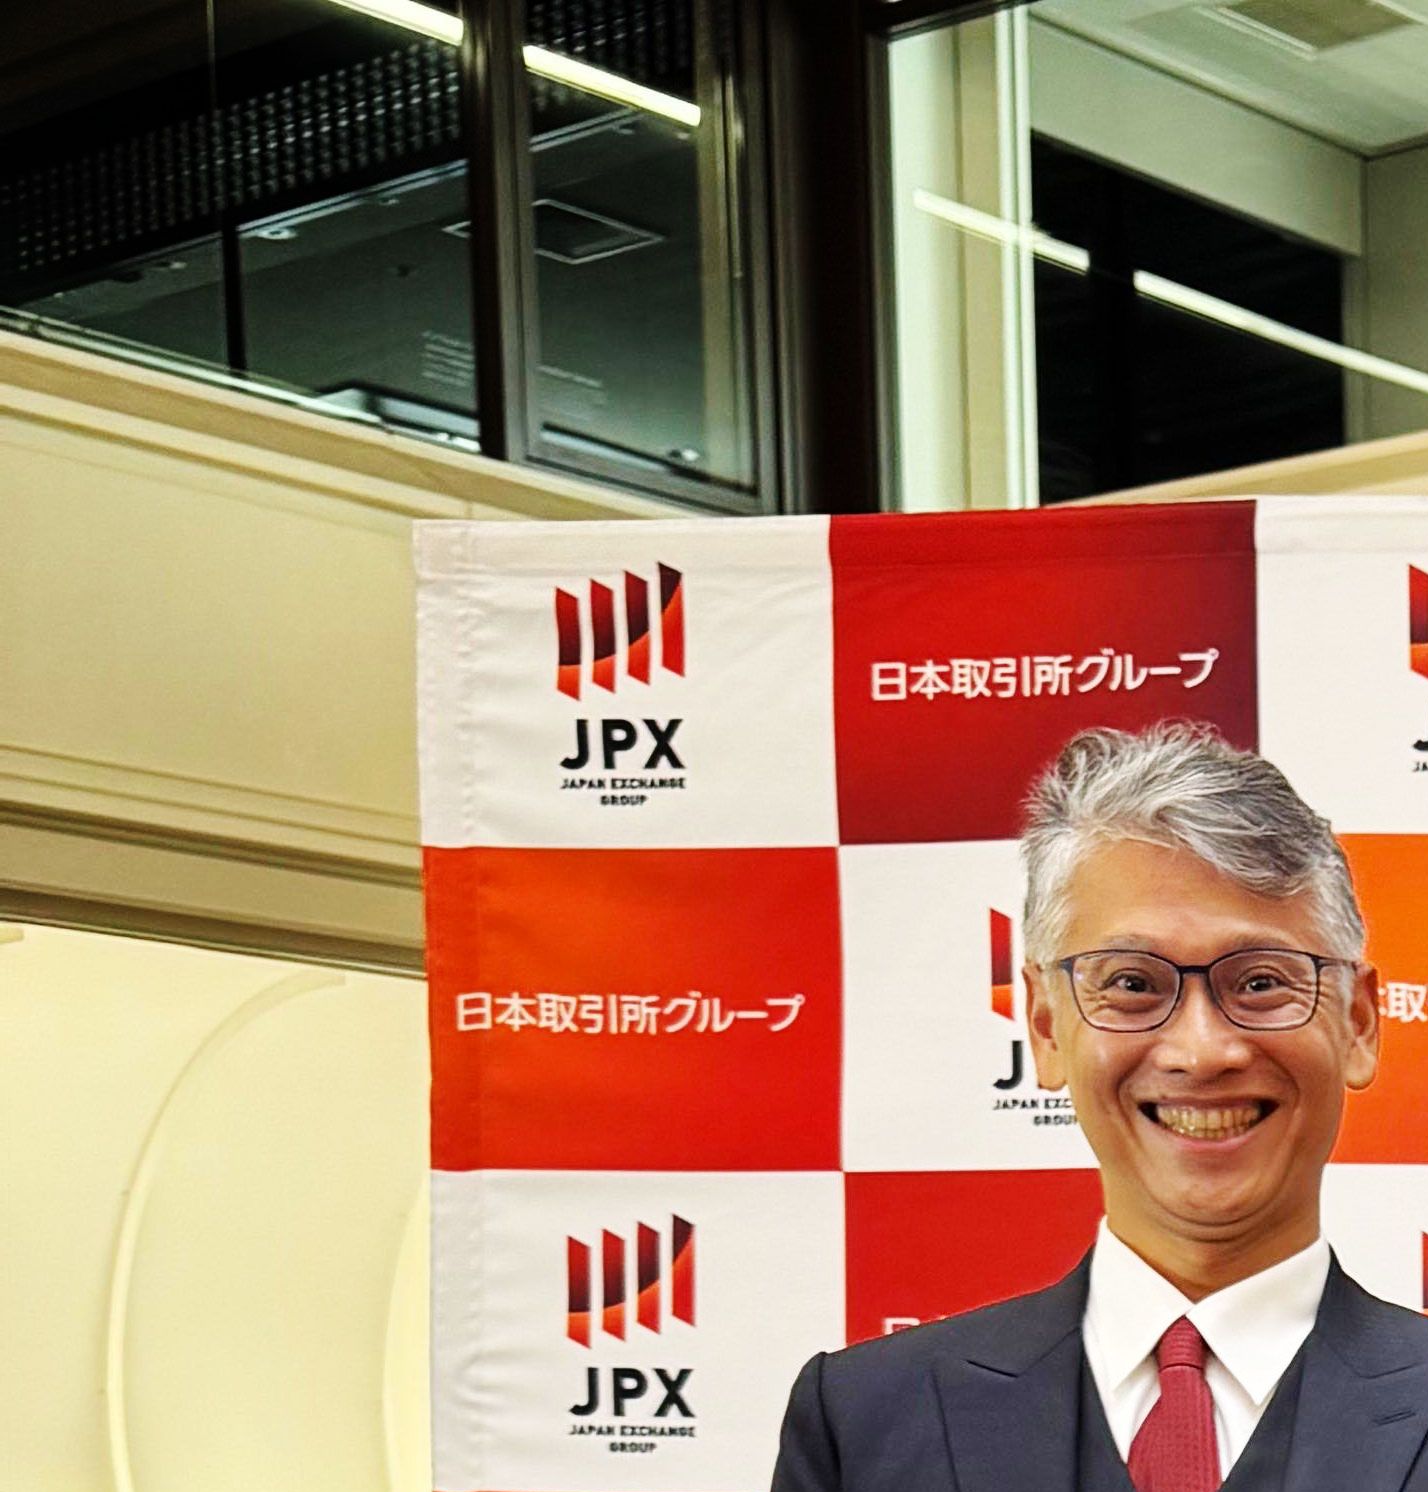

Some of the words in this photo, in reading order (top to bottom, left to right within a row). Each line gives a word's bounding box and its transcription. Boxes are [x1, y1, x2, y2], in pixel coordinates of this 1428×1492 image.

[872, 647, 1219, 701] 日本取引所グループ
[560, 718, 685, 770] JPX
[559, 777, 607, 791] JAPAN
[610, 777, 686, 791] EXCHANGE
[599, 794, 648, 807] GROUP
[457, 991, 805, 1034] 日本取引所グループ
[569, 1367, 695, 1418] JPX
[568, 1424, 616, 1438] JAPAN
[619, 1424, 696, 1438] EXCHANGE
[608, 1441, 657, 1454] GROUP
